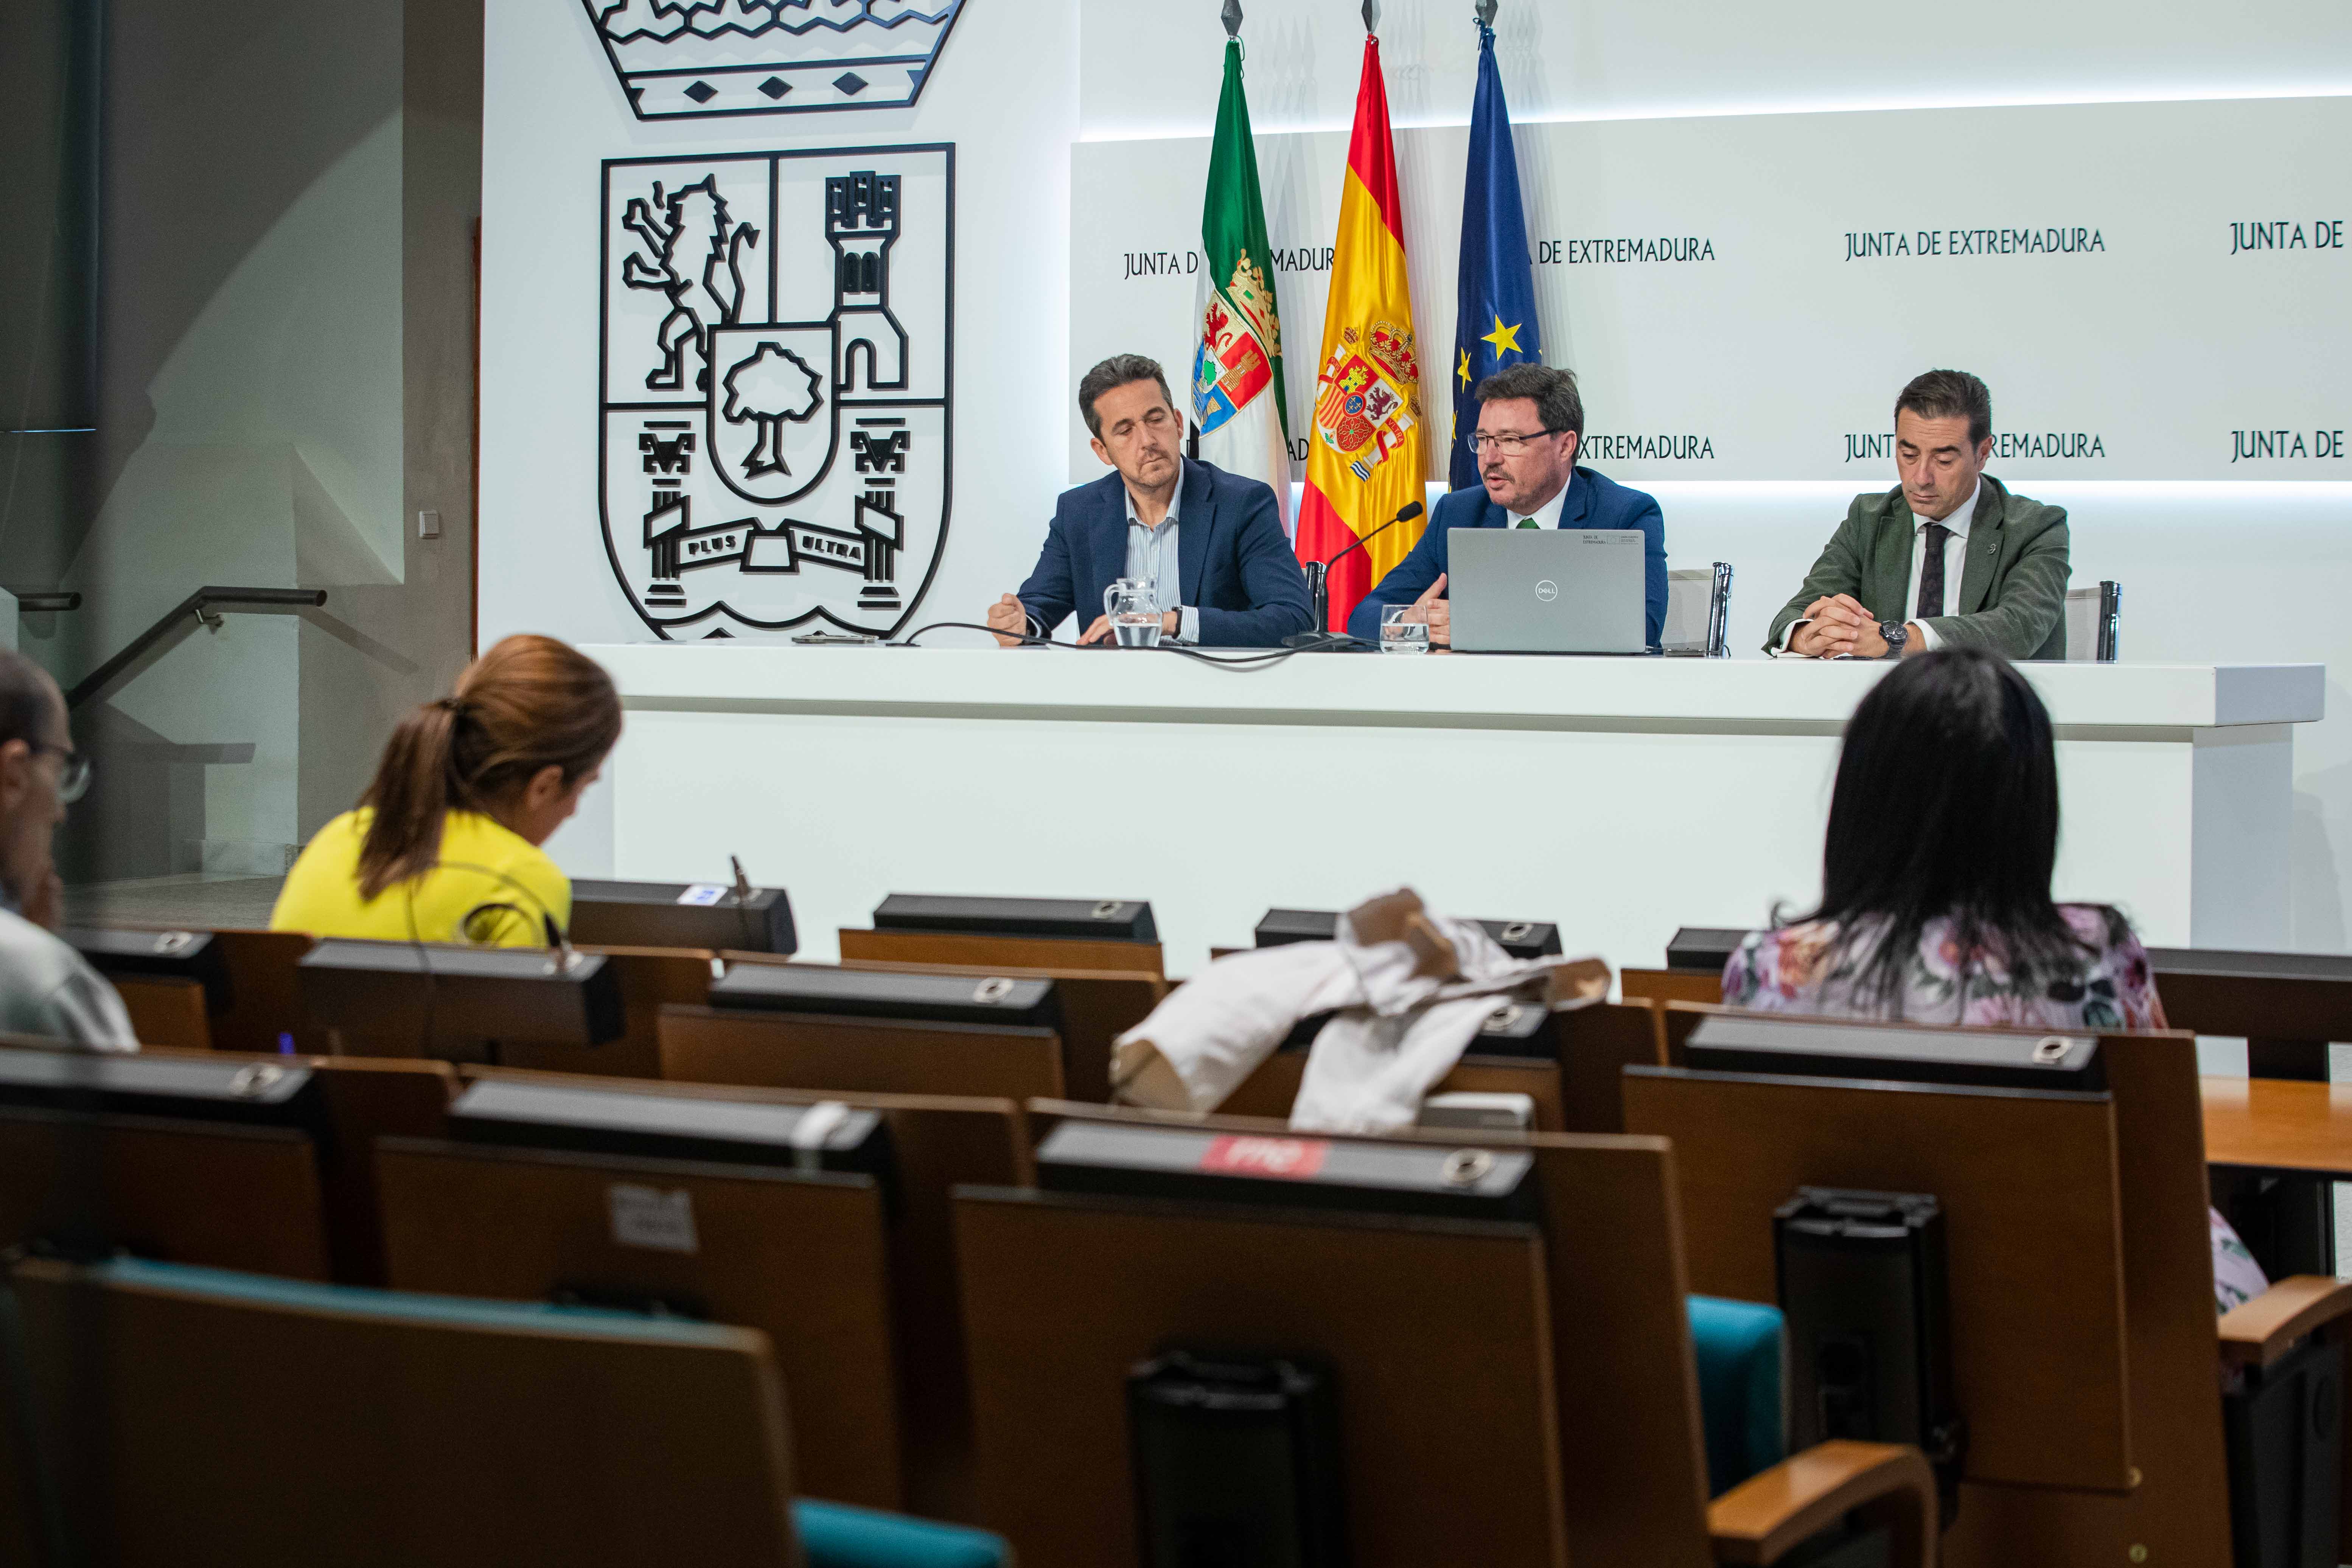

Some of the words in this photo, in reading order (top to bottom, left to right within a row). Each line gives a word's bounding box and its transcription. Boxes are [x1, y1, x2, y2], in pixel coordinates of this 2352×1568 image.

[1539, 241, 1562, 264] DE
[1569, 238, 1715, 263] EXTREMADURA
[1845, 232, 1910, 261] JUNTA
[1917, 230, 1942, 255] DE
[1949, 228, 2105, 255] EXTREMADURA
[2229, 222, 2307, 255] JUNTA
[2314, 221, 2344, 249] DE
[1124, 252, 1180, 280] JUNTA
[1187, 251, 1200, 274] D
[1388, 419, 1404, 443] VLTRA
[1578, 435, 1715, 459] XTREMADURA
[1844, 434, 1896, 463] JUNT
[1991, 433, 2105, 458] REMADURA
[2231, 431, 2307, 463] JUNTA
[2315, 430, 2344, 458] DE
[688, 535, 737, 555] PLUS
[802, 536, 862, 560] ULTRA
